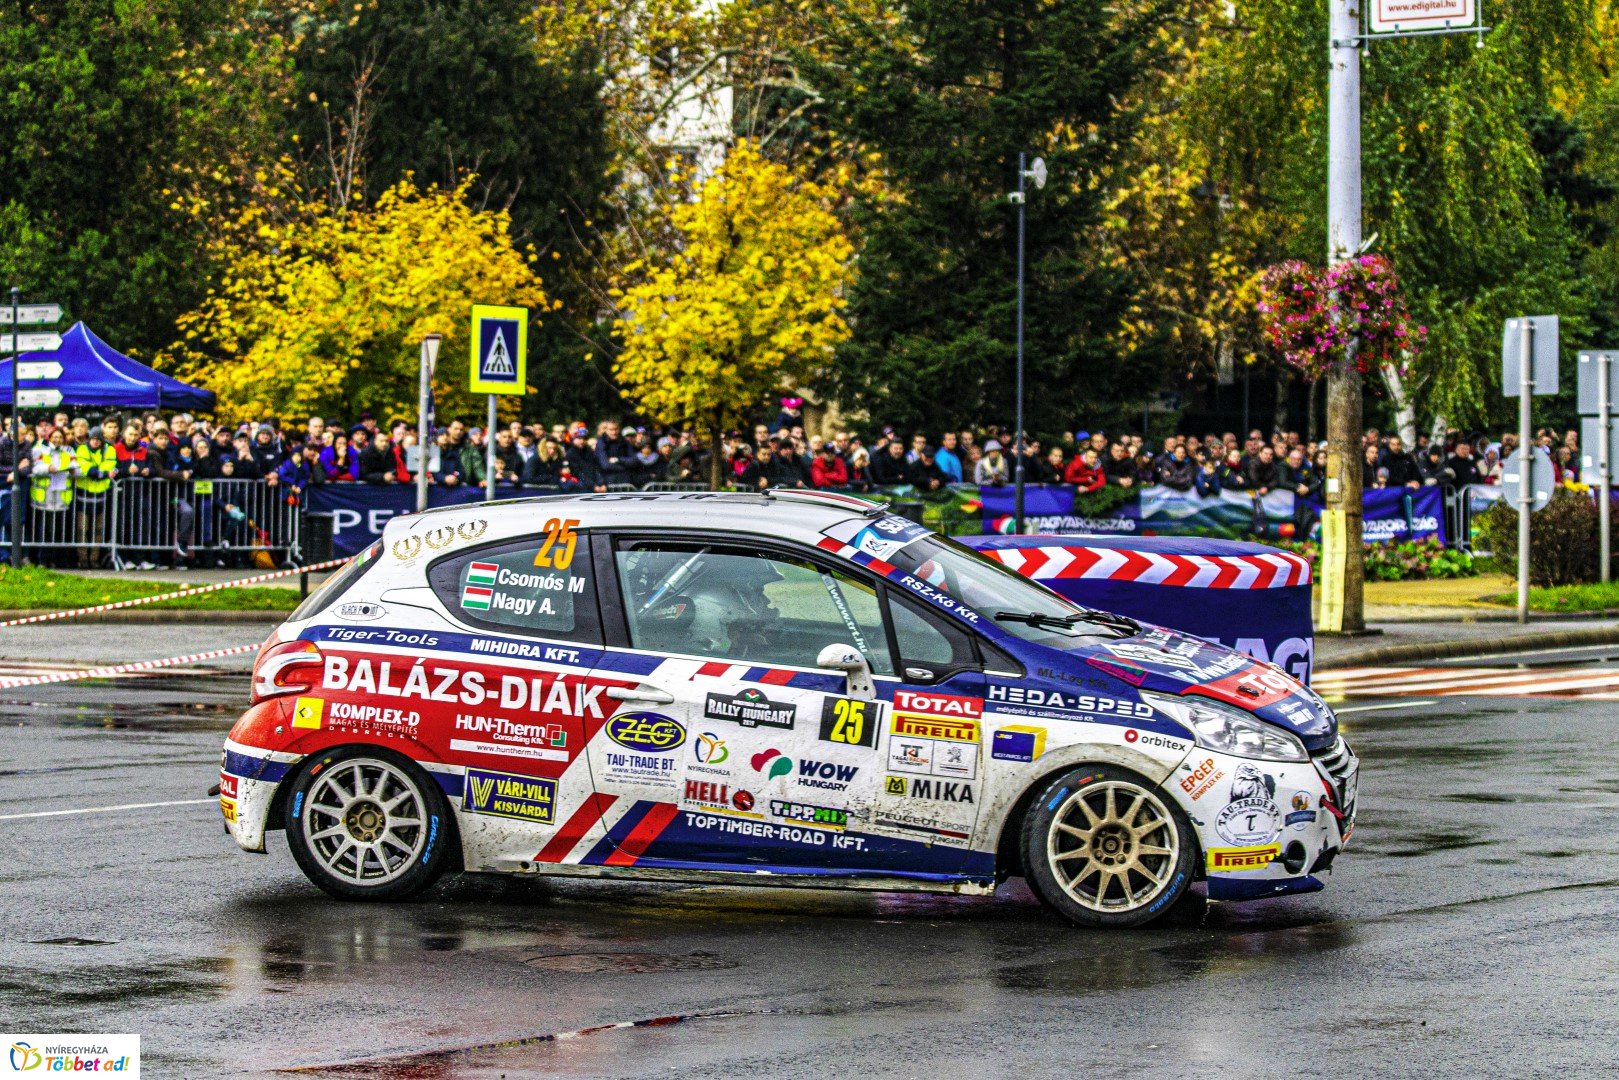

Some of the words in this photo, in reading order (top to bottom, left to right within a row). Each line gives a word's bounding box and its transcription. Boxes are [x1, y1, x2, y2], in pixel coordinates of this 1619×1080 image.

[1388, 0, 1457, 12] www.edigital.hu
[333, 509, 410, 535] PE
[534, 518, 580, 570] 25
[499, 568, 564, 591] Csomós
[567, 577, 585, 594] M
[493, 592, 537, 615] Nagy
[539, 599, 556, 615] A.
[328, 628, 439, 646] Tiger-Tools
[470, 638, 540, 658] MIHIDRA
[545, 648, 580, 662] KFT.
[322, 656, 606, 718] BALÁZS-DIÁK
[708, 699, 741, 716] RALLY
[742, 707, 794, 724] HUNGARY
[897, 691, 980, 716] TOTAL
[988, 685, 1154, 718] HEDA-SPED
[329, 718, 356, 727] MAGAS
[330, 703, 420, 726] KOMPLEX-D
[456, 714, 545, 737] HUN-Therm
[830, 699, 865, 745] 25
[493, 733, 530, 744] Consulting
[896, 715, 974, 740] PIRELLI
[476, 744, 543, 757] www.huntherm.hu
[1141, 733, 1186, 751] orbitex
[607, 753, 659, 769] TAU-TRADE
[662, 759, 677, 771] BT.
[612, 767, 670, 777] www.tautrade.hu
[800, 759, 859, 782] WOW
[798, 778, 848, 791] HUNGARY
[1180, 758, 1215, 793] ÉPGÉP
[496, 778, 550, 801] VÁRI-VILL
[685, 780, 729, 805] HELL
[911, 779, 974, 803] MIKA
[1191, 778, 1217, 801] KOMPLEX
[494, 801, 548, 818] KISVÁRDA
[875, 810, 939, 827] PEUGEOT
[941, 821, 970, 832] SPORT
[1218, 798, 1268, 826] TAU-TRADE
[832, 834, 869, 852] KFT.
